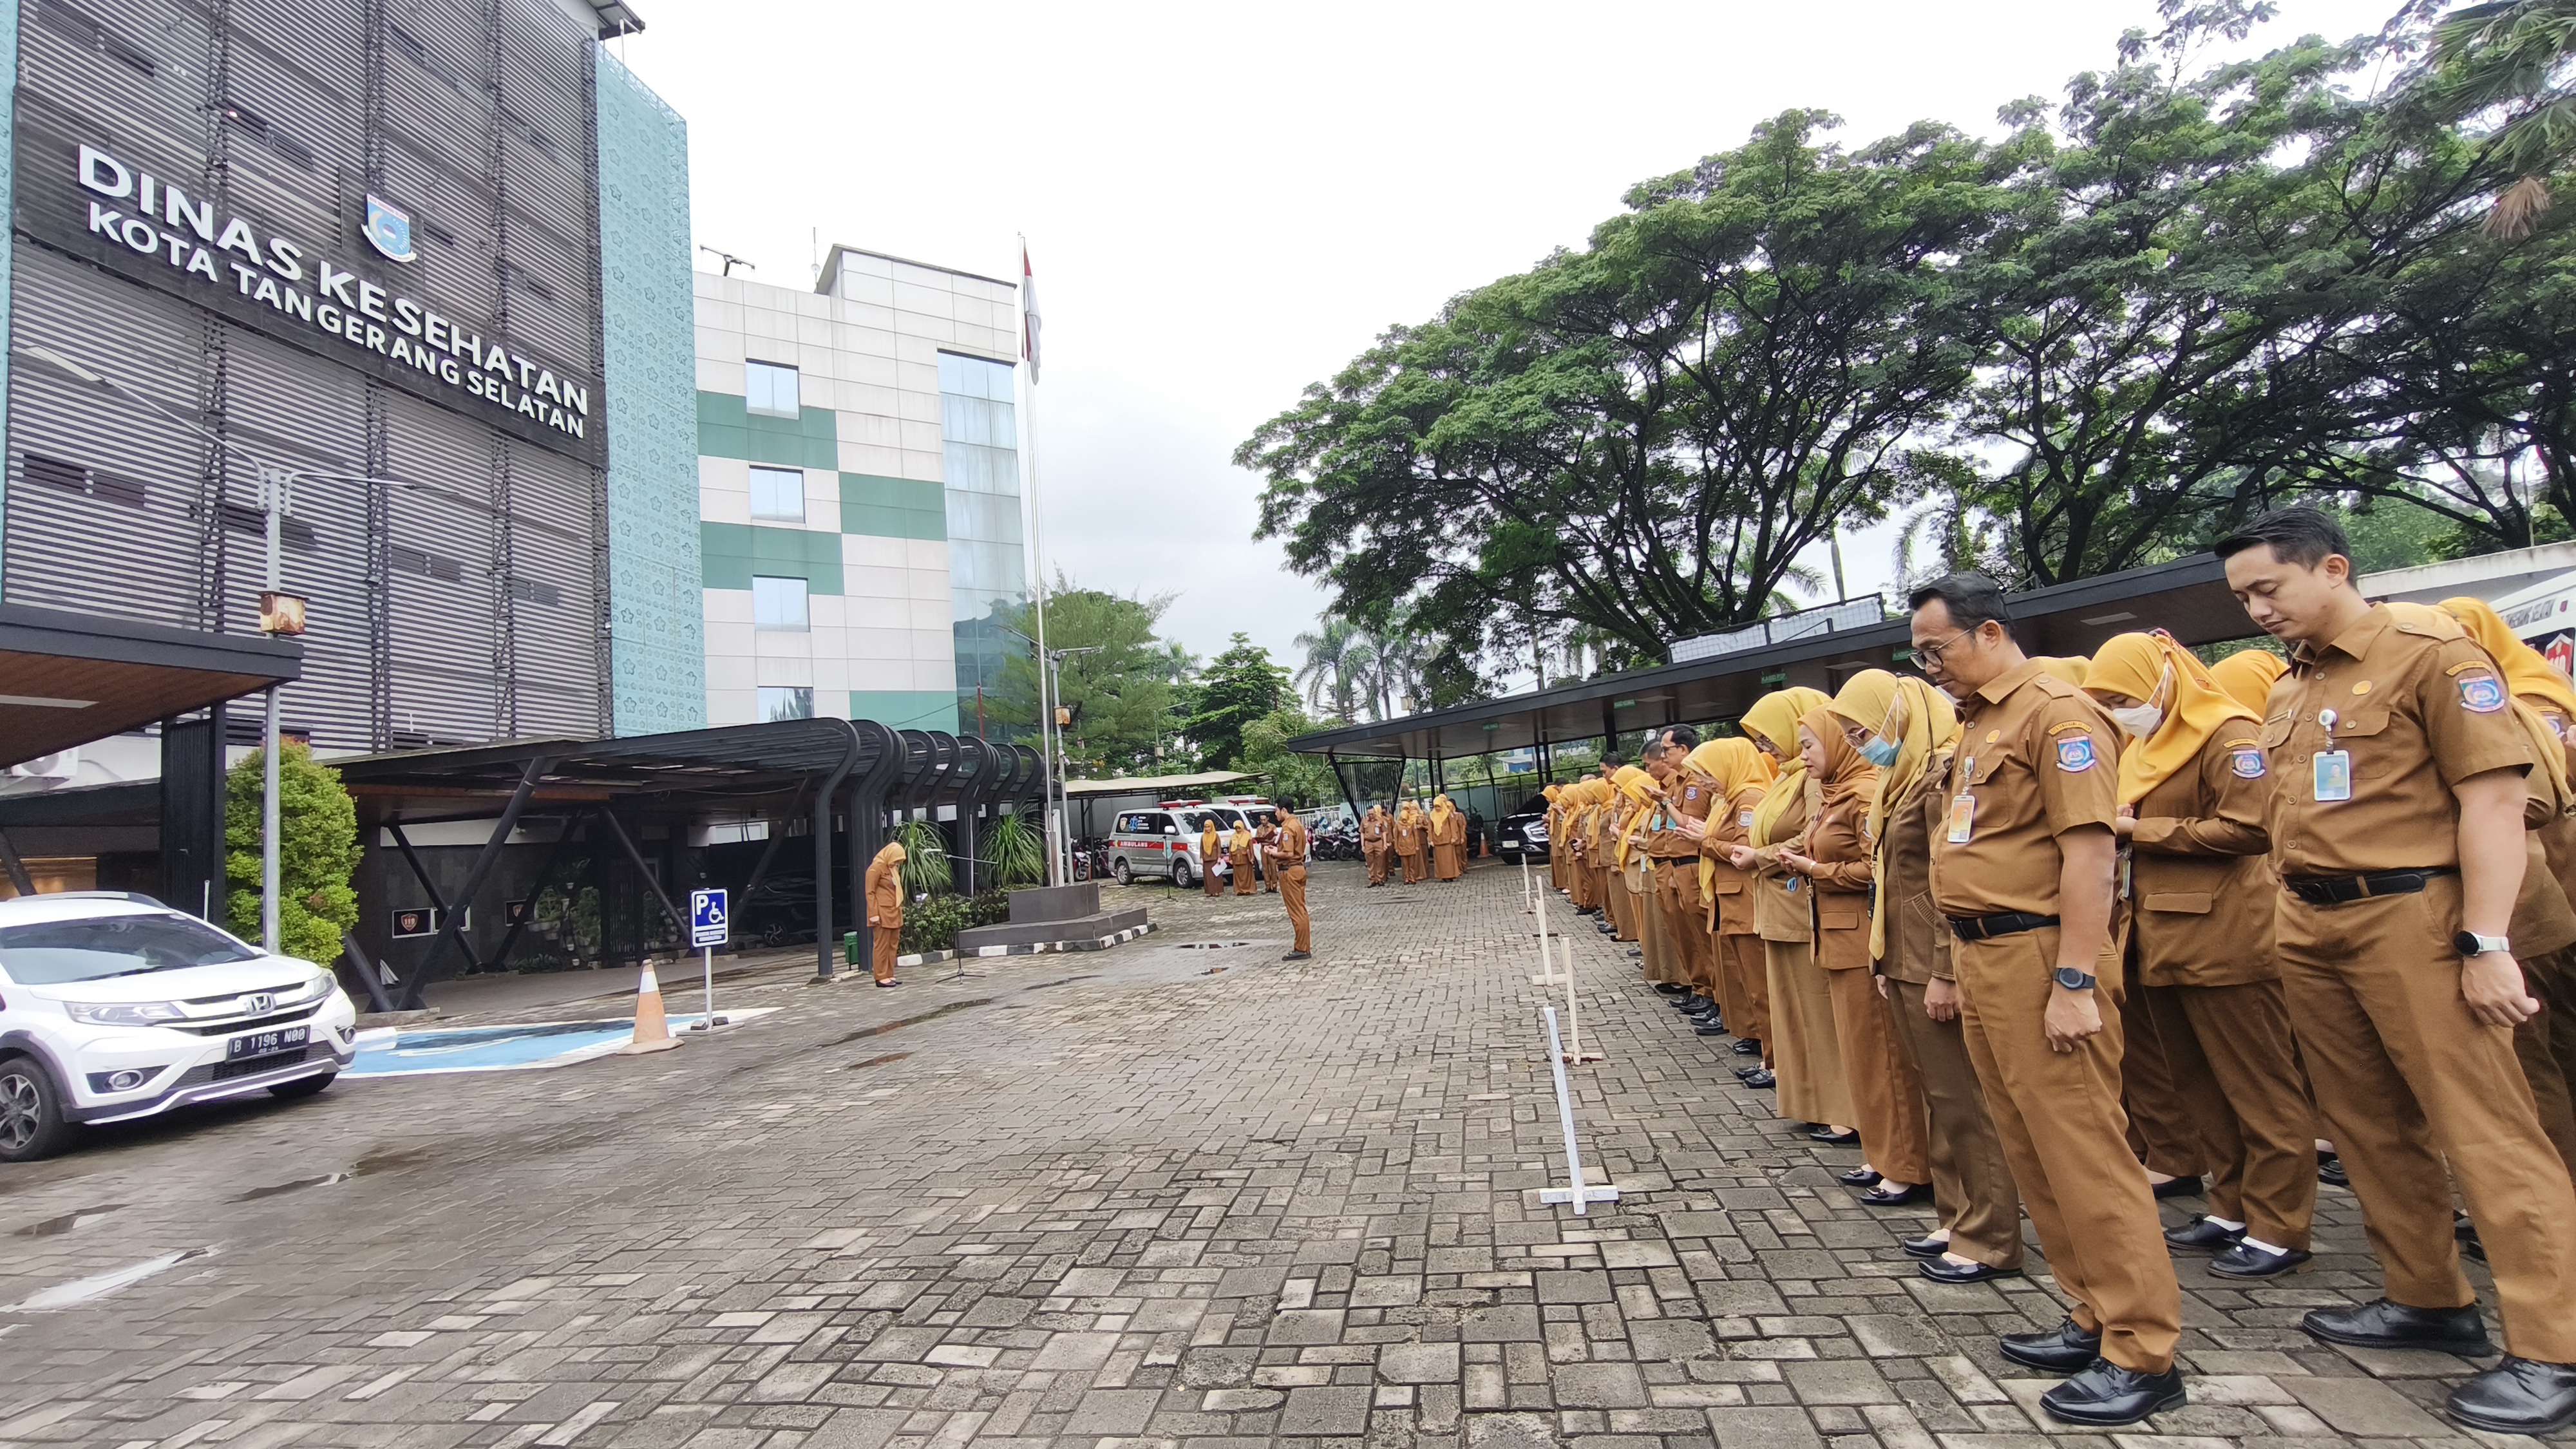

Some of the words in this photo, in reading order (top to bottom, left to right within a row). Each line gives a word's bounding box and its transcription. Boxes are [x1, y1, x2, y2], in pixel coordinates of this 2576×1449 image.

[79, 144, 303, 280] DINAS
[320, 260, 588, 416] KESEHATAN
[89, 202, 218, 283] KOTA
[231, 262, 460, 385] TANGERANG
[466, 370, 584, 439] SELATAN
[696, 895, 709, 916] P
[234, 1039, 242, 1052] B
[251, 1033, 278, 1049] 1196
